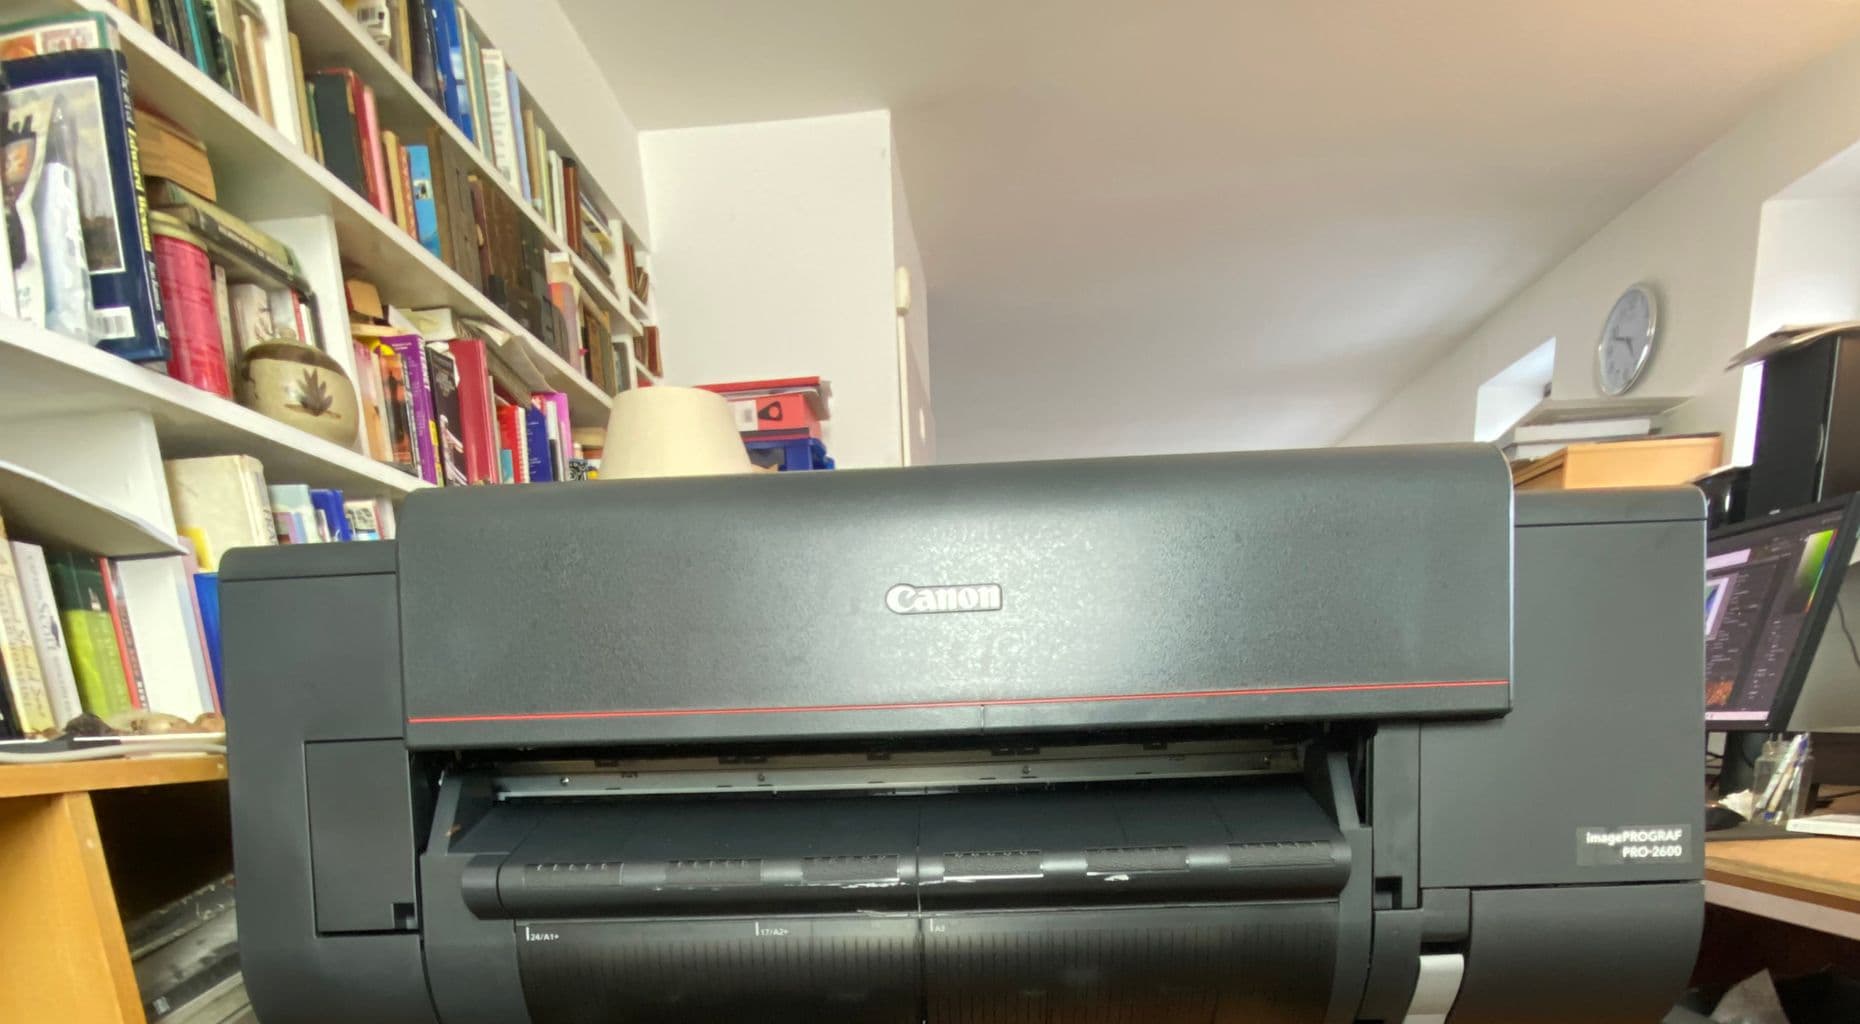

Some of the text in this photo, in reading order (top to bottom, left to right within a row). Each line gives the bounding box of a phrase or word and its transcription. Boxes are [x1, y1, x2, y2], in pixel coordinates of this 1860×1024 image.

[886, 584, 1001, 613] Canon
[1586, 829, 1683, 846] imagePROGRAF
[1622, 845, 1683, 858] PRO-2600
